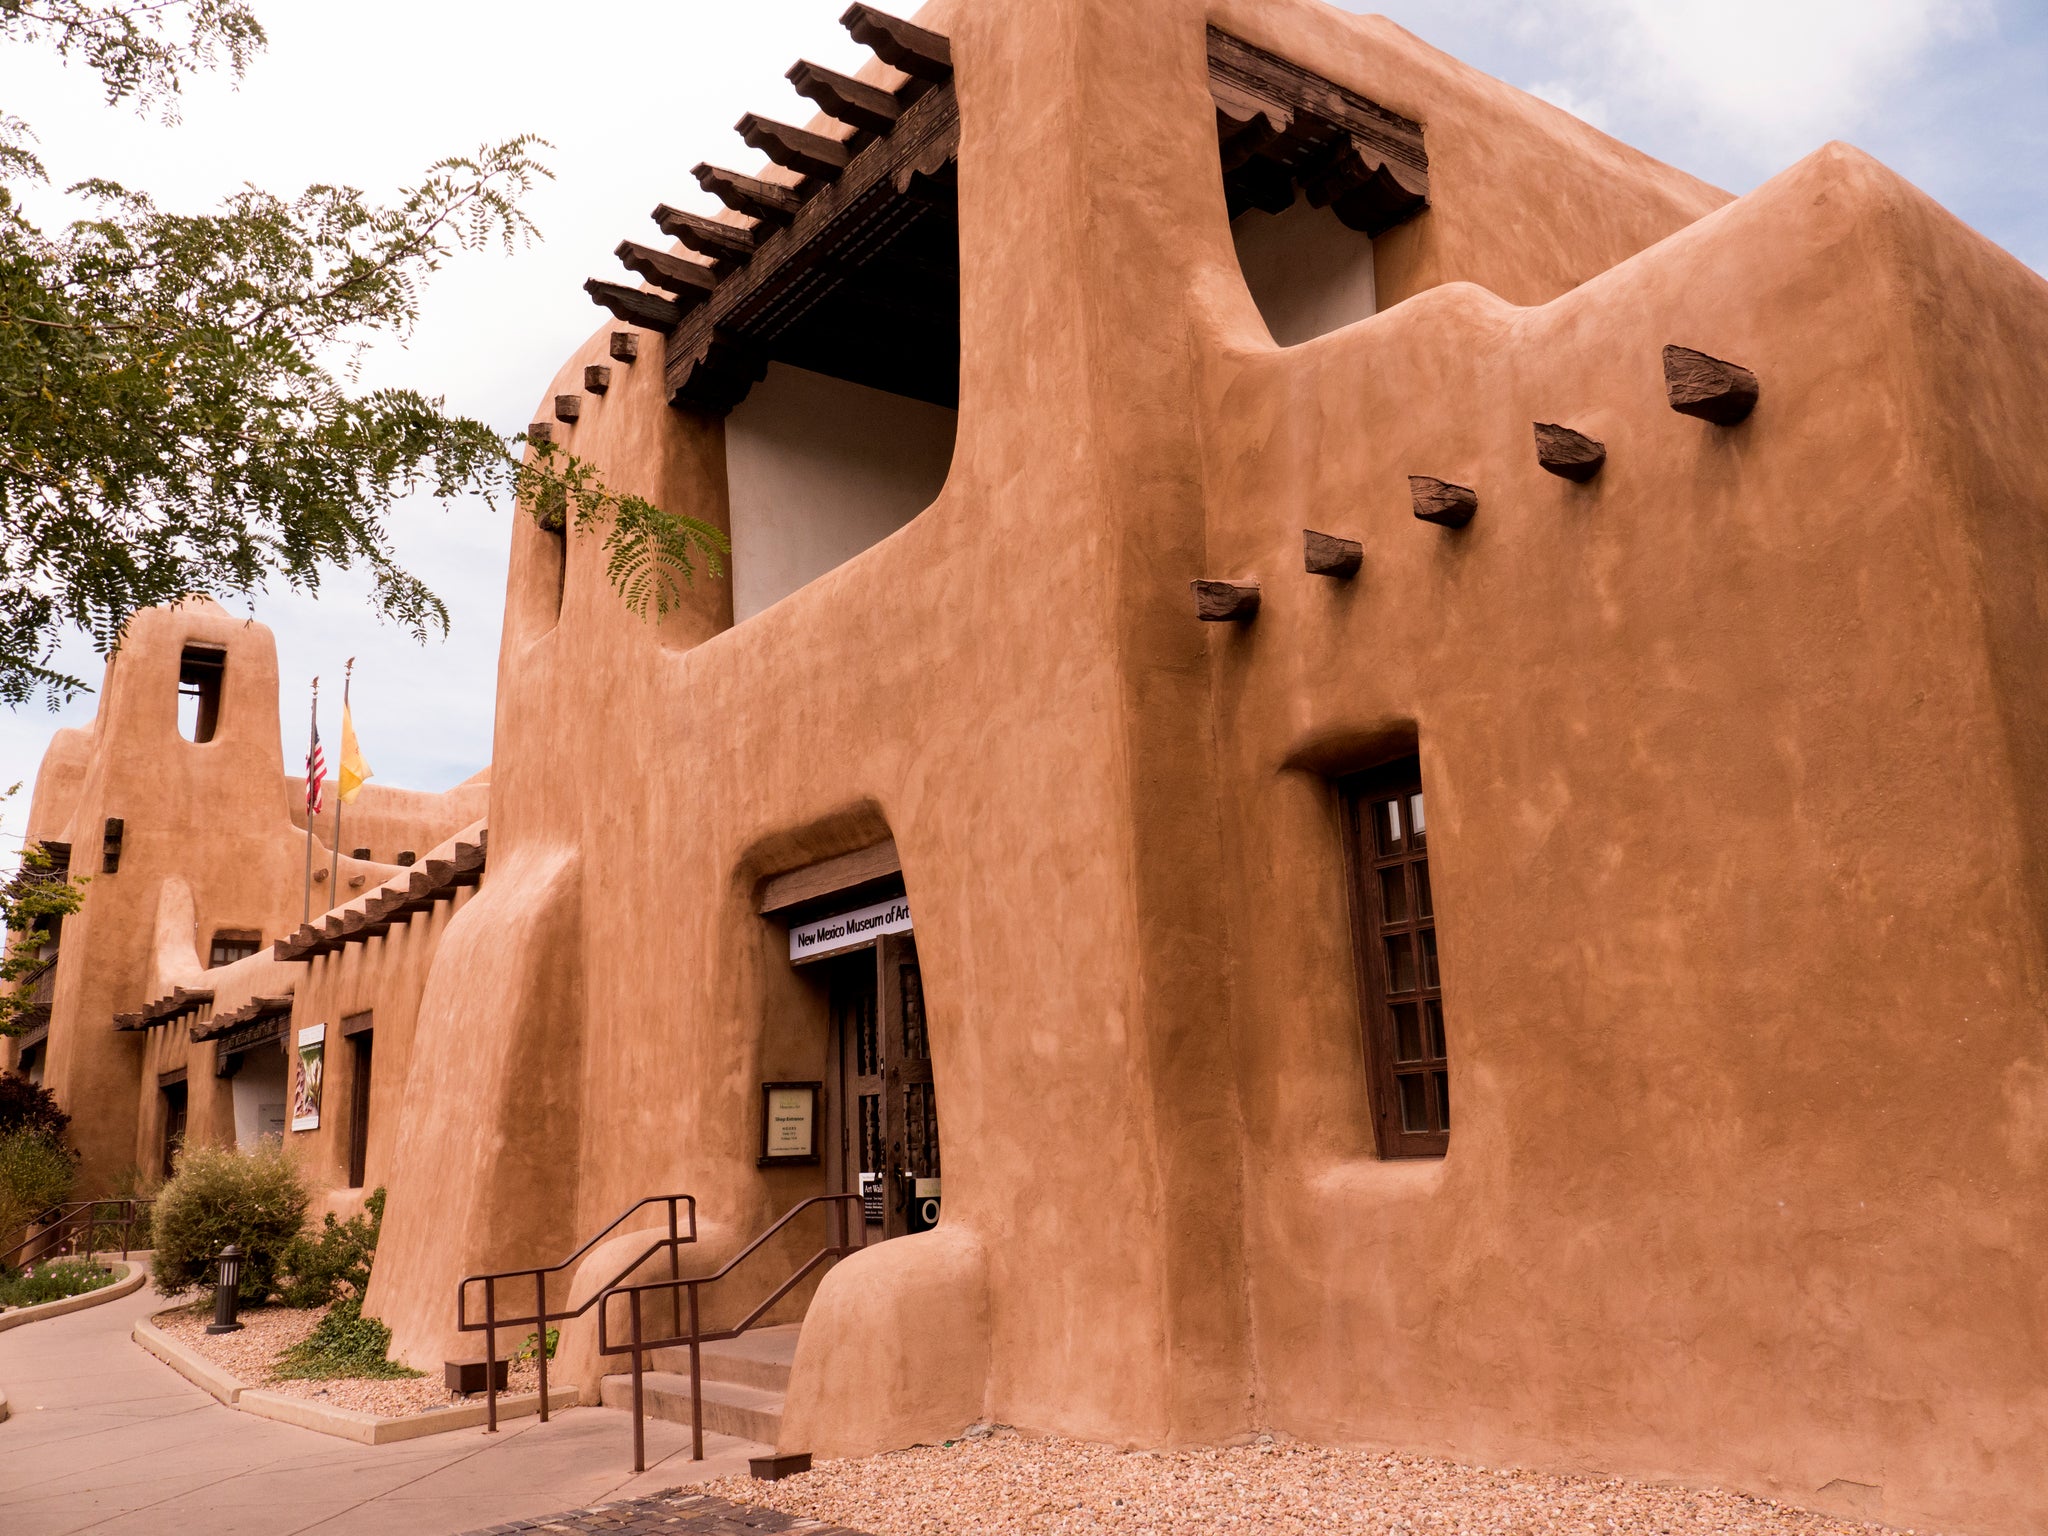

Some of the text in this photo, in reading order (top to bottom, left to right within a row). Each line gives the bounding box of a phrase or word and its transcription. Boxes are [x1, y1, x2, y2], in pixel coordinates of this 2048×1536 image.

[798, 904, 910, 948] New Mexico Museum of Art
[864, 1184, 872, 1193] Art
